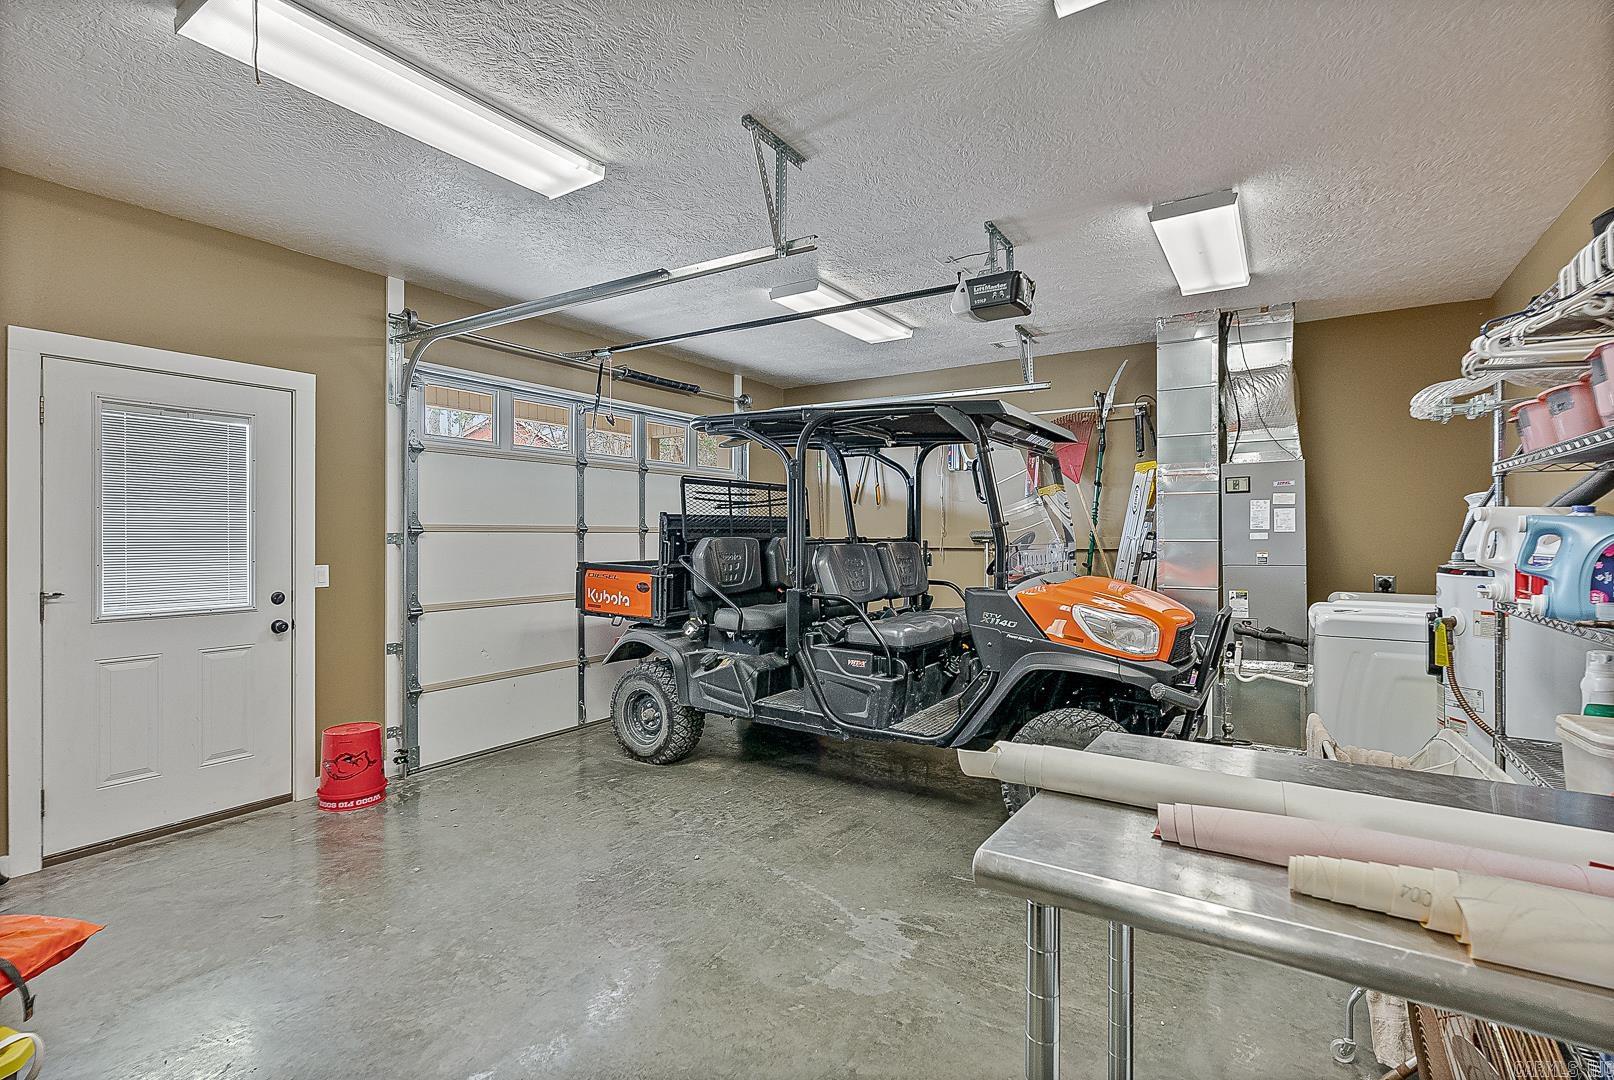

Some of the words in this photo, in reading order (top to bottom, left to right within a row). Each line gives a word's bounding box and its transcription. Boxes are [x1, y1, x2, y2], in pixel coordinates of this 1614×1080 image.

[973, 282, 1007, 293] LiftMaster
[588, 572, 619, 580] DIESEL
[587, 587, 630, 606] Kubota
[982, 611, 1002, 619] RTV
[980, 617, 1018, 628] X1140
[338, 800, 354, 808] PIG
